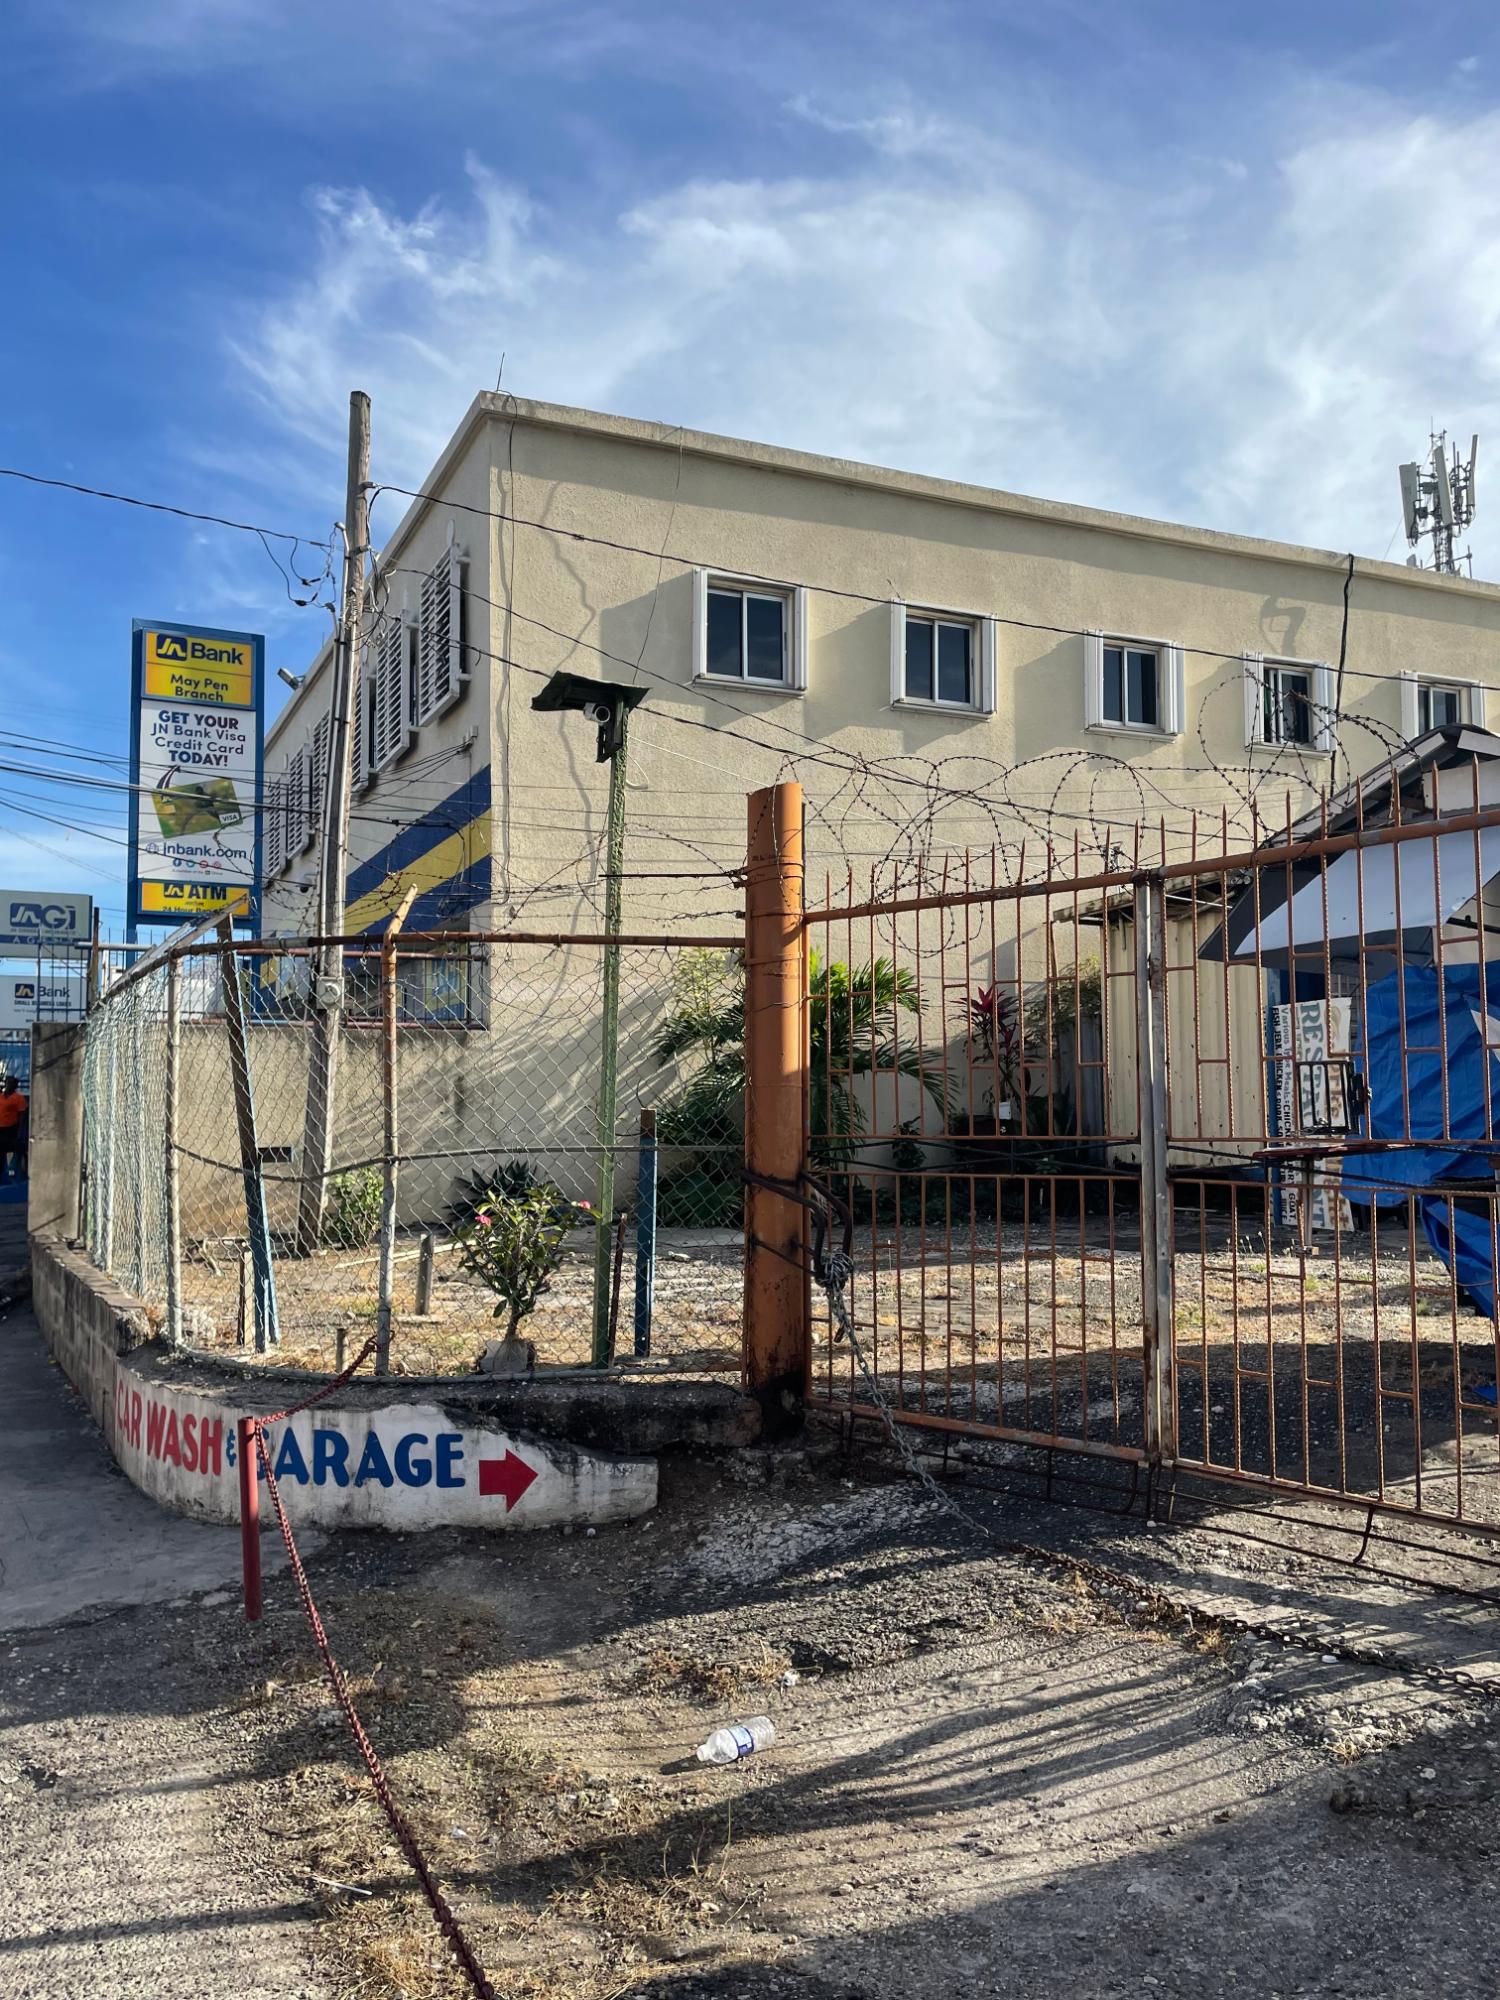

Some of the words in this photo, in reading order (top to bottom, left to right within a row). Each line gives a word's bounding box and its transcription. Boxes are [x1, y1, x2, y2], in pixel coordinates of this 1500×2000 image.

[191, 643, 243, 665] Bank
[170, 674, 200, 689] May
[204, 678, 228, 691] Pen
[175, 687, 223, 702] Branch
[158, 710, 189, 724] GET
[194, 713, 239, 730] YOUR
[150, 723, 168, 736] JN
[174, 725, 212, 739] Bank
[216, 729, 246, 742] Visa
[155, 737, 202, 751] Credit
[206, 742, 244, 755] Card
[169, 750, 228, 767] TODAY!
[222, 814, 238, 822] VISA
[163, 842, 247, 860] jnbank.com
[189, 884, 226, 900] ATM
[38, 986, 70, 998] Bank
[117, 1379, 142, 1450] CAR
[147, 1400, 222, 1476] WASH
[226, 1429, 236, 1467] &
